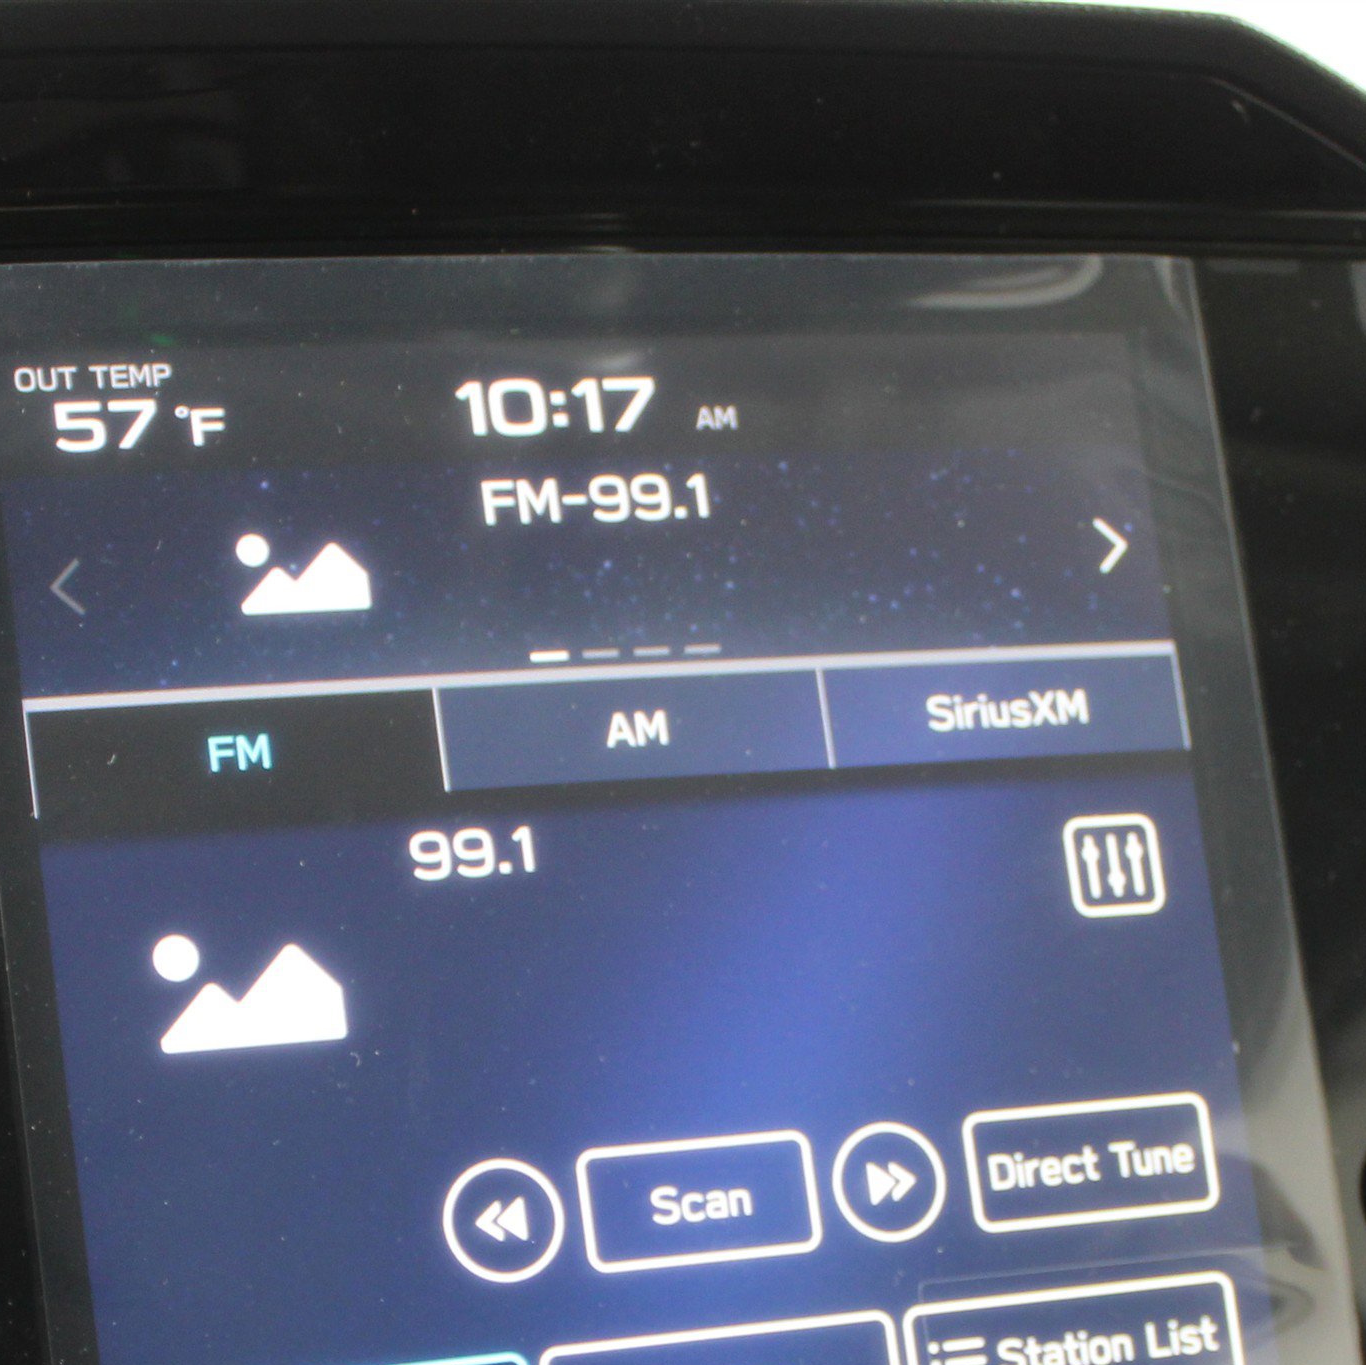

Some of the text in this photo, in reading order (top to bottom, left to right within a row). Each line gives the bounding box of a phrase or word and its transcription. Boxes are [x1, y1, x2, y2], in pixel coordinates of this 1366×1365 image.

[13, 362, 172, 393] OUT TEMP
[53, 397, 157, 453] 57
[455, 375, 738, 437] 10:17 AM
[480, 472, 710, 526] FM-99.1
[606, 709, 669, 749] AM
[925, 688, 1089, 732] SiriusXM
[207, 733, 272, 773] FM
[408, 825, 536, 881] 99.1
[987, 1140, 1195, 1191] Direct Tune
[650, 1186, 753, 1225] Scan
[1145, 1316, 1220, 1359] List
